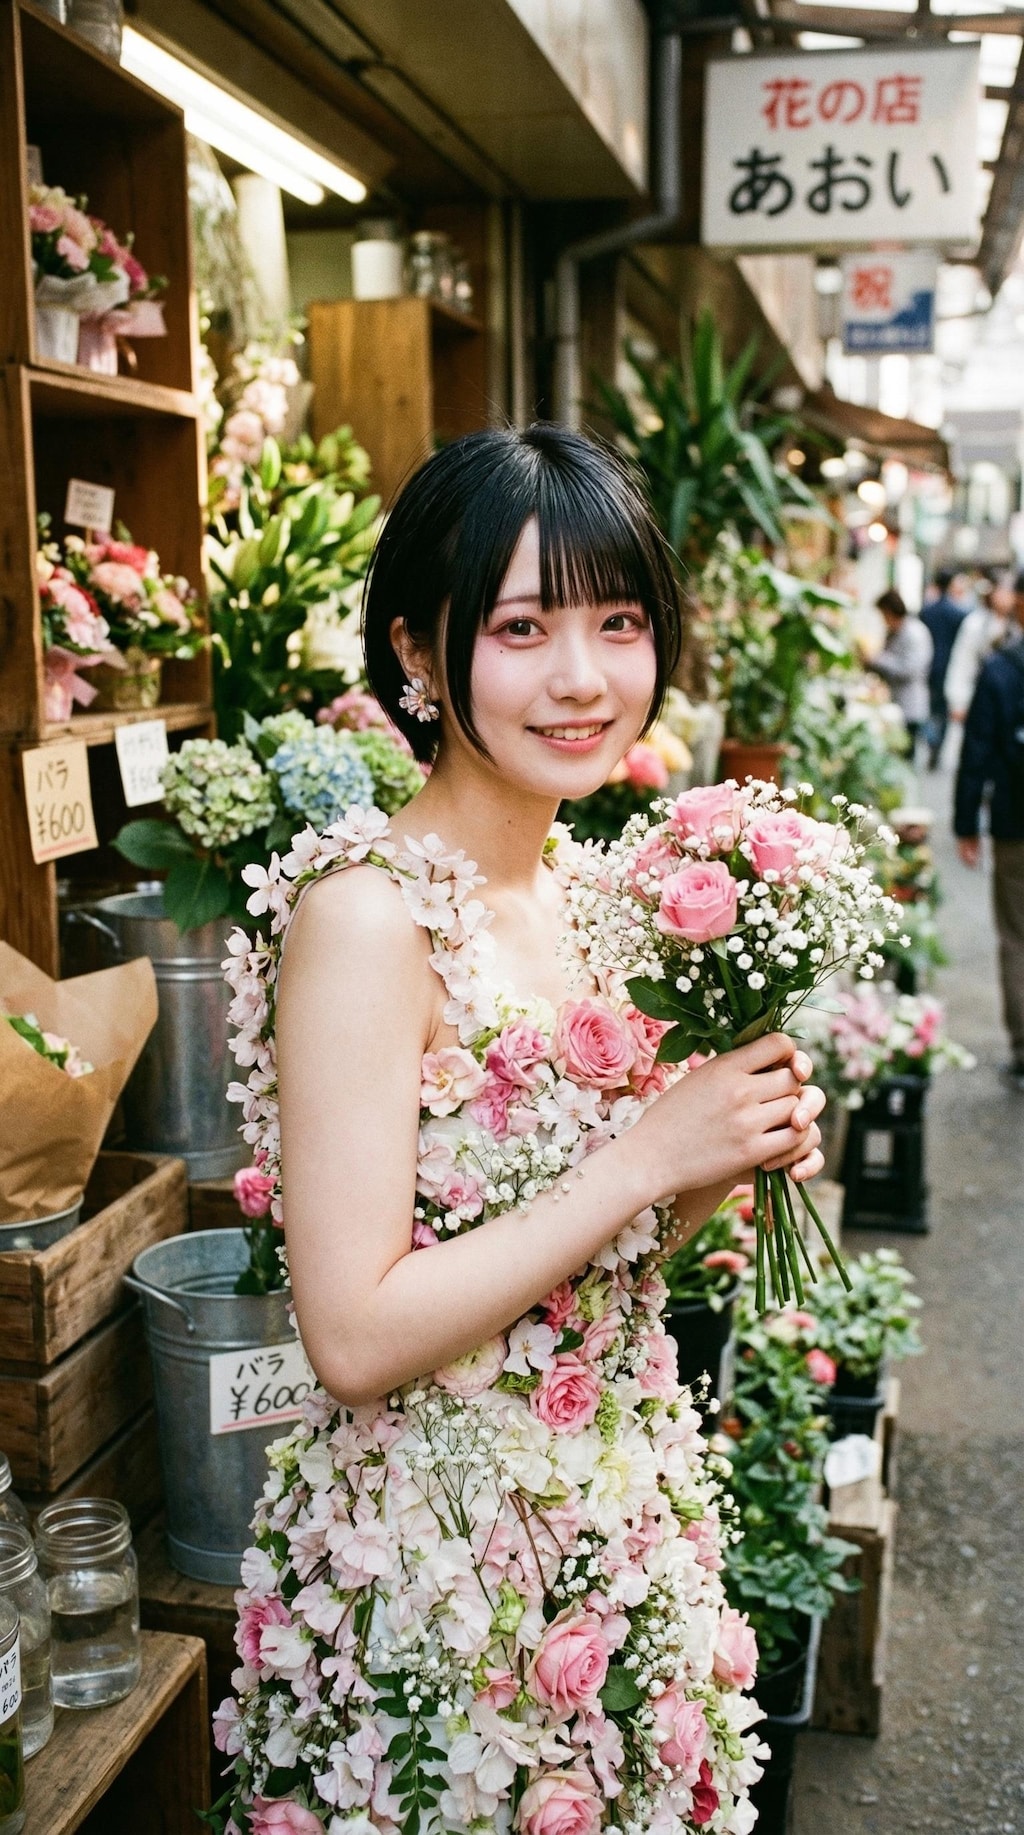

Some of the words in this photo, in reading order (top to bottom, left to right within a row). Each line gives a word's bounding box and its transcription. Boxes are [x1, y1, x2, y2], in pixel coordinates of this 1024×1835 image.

[761, 73, 923, 132] 花の店
[729, 145, 952, 217] あおい
[37, 759, 69, 793] バラ
[35, 801, 86, 845] ¥600
[236, 1352, 285, 1380] バラ
[229, 1382, 311, 1421] ¥600
